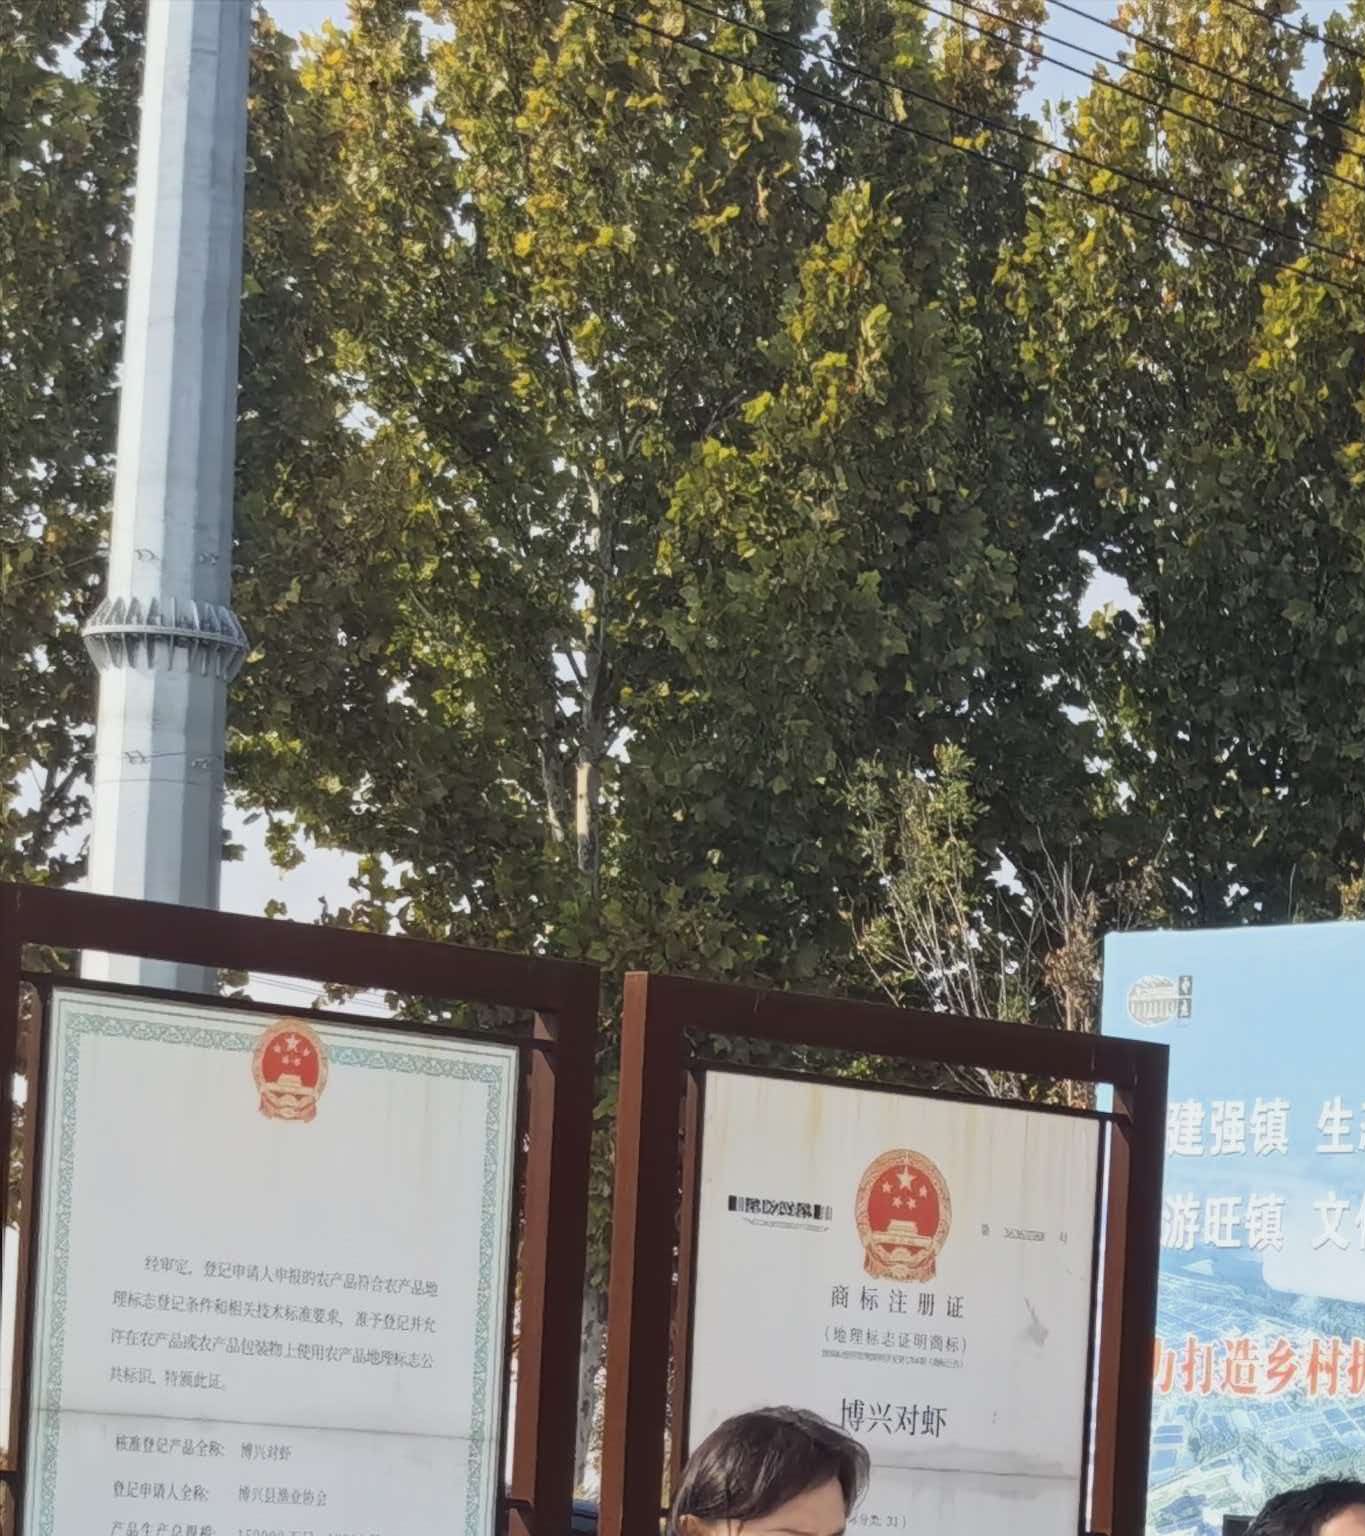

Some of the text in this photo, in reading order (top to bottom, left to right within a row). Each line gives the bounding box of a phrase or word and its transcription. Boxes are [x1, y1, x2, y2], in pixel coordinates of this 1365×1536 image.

[1166, 1097, 1292, 1156] 建强镇
[1160, 1191, 1287, 1251] 游旺镇
[831, 1285, 966, 1319] 商标注册证
[841, 1398, 949, 1438] 博兴对虾
